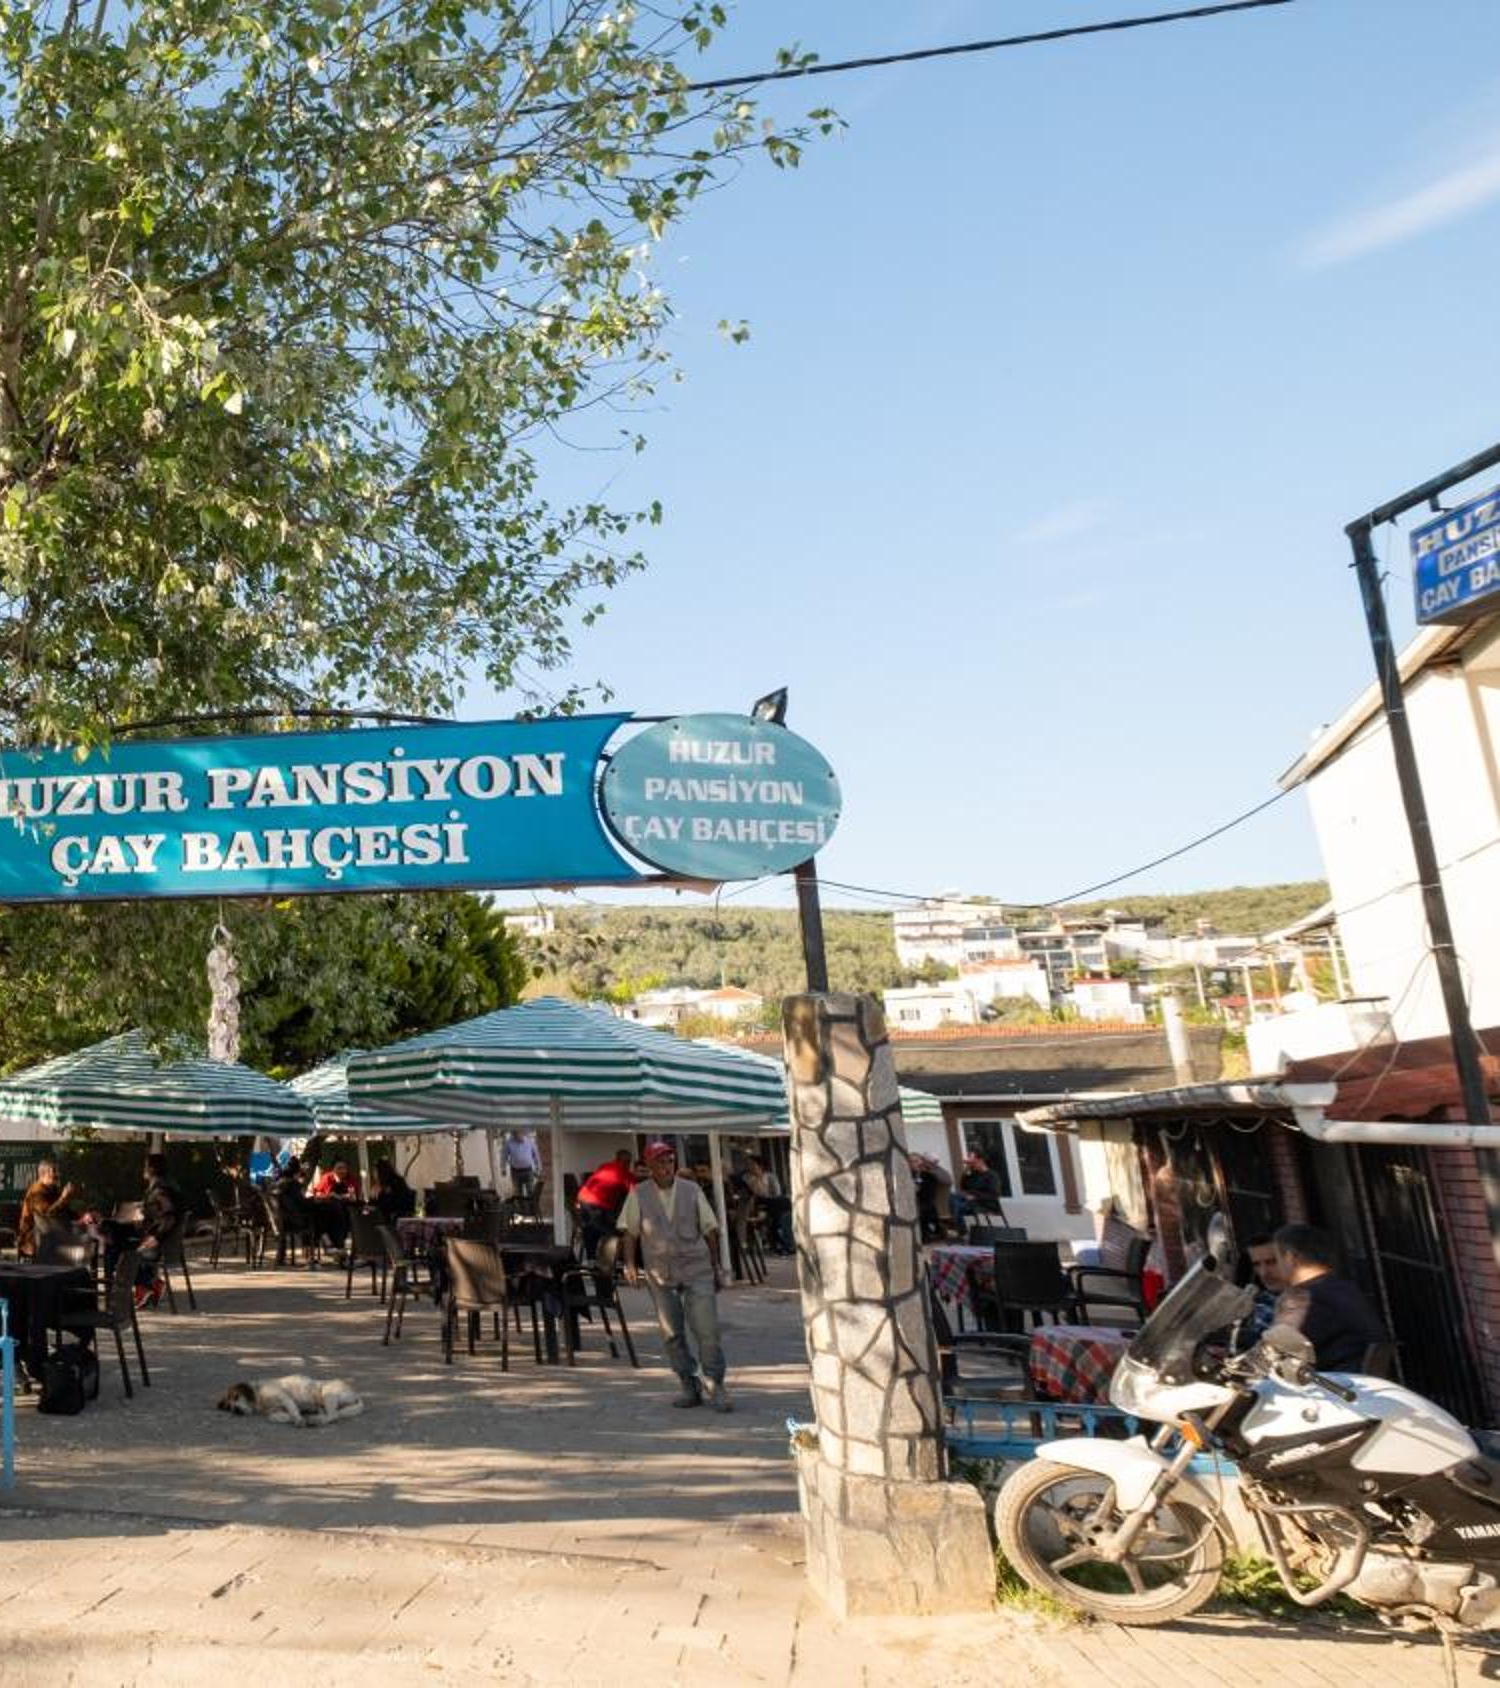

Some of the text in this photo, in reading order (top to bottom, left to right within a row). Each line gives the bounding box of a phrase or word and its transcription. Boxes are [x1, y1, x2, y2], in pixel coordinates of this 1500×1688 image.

[669, 738, 777, 766] HUZUR
[206, 746, 565, 810] PANSİYON
[644, 773, 803, 806] PANSİYON
[51, 809, 469, 887] ÇAY BAHÇESİ
[625, 815, 827, 851] ÇAY BAHÇESİ
